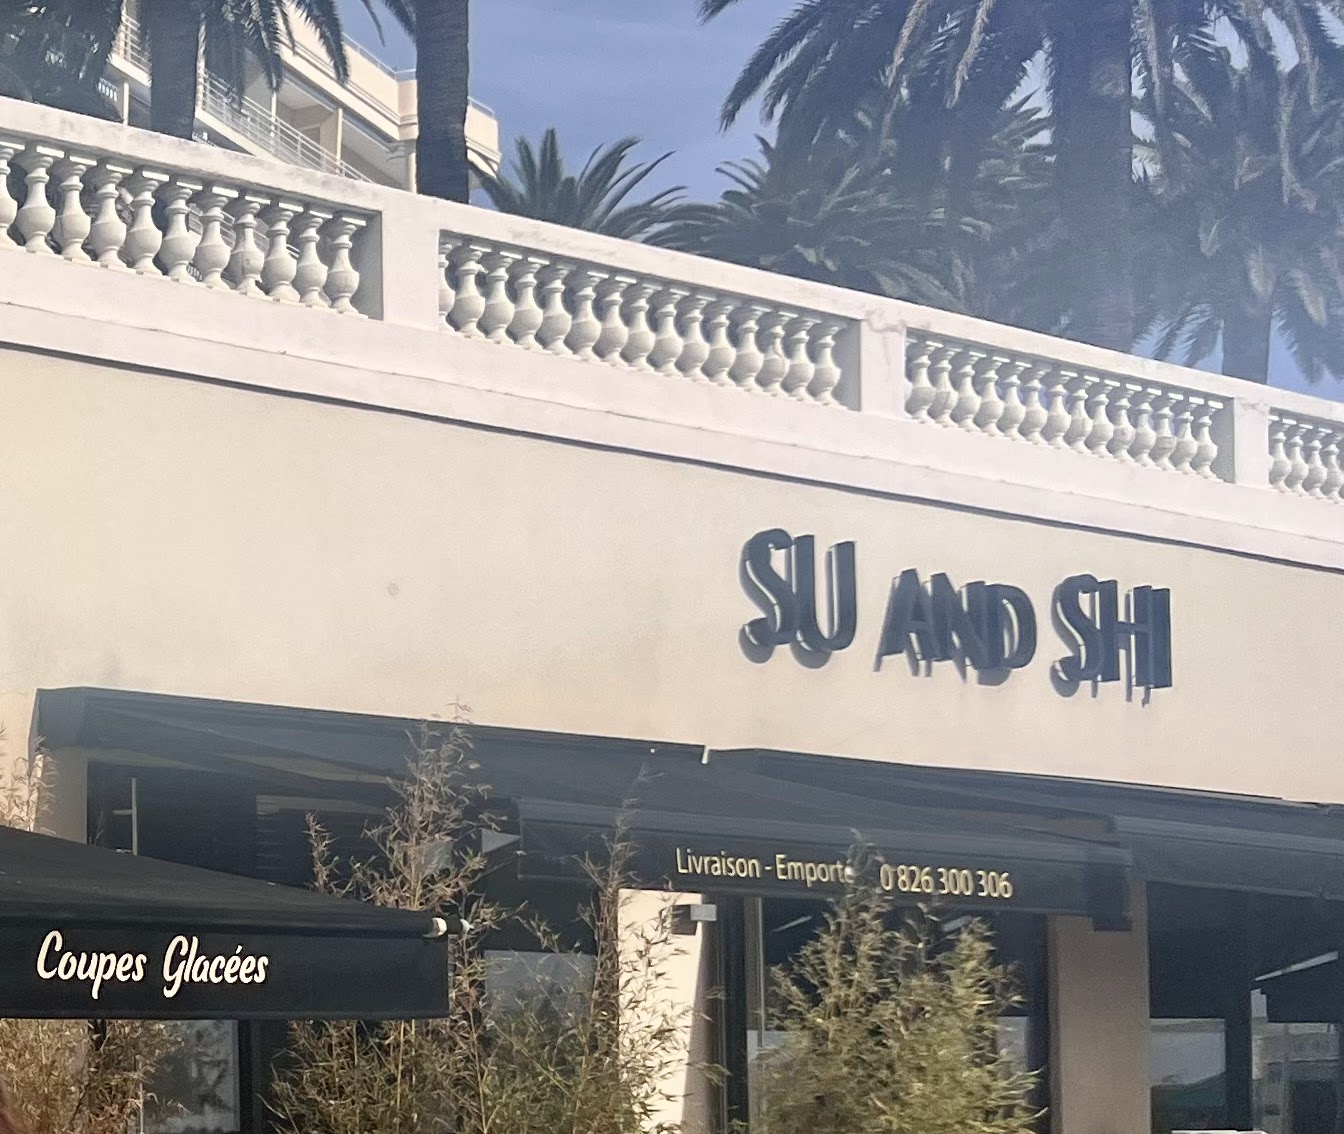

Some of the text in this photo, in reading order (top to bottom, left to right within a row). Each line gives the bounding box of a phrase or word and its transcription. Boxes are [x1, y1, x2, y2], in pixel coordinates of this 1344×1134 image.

[739, 527, 1173, 692] SU AND SHI
[675, 847, 761, 879] Livraison
[775, 853, 857, 888] Emporte
[937, 868, 974, 897] 300
[977, 870, 1013, 899] 306
[36, 929, 270, 1000] Coupes Glacées
